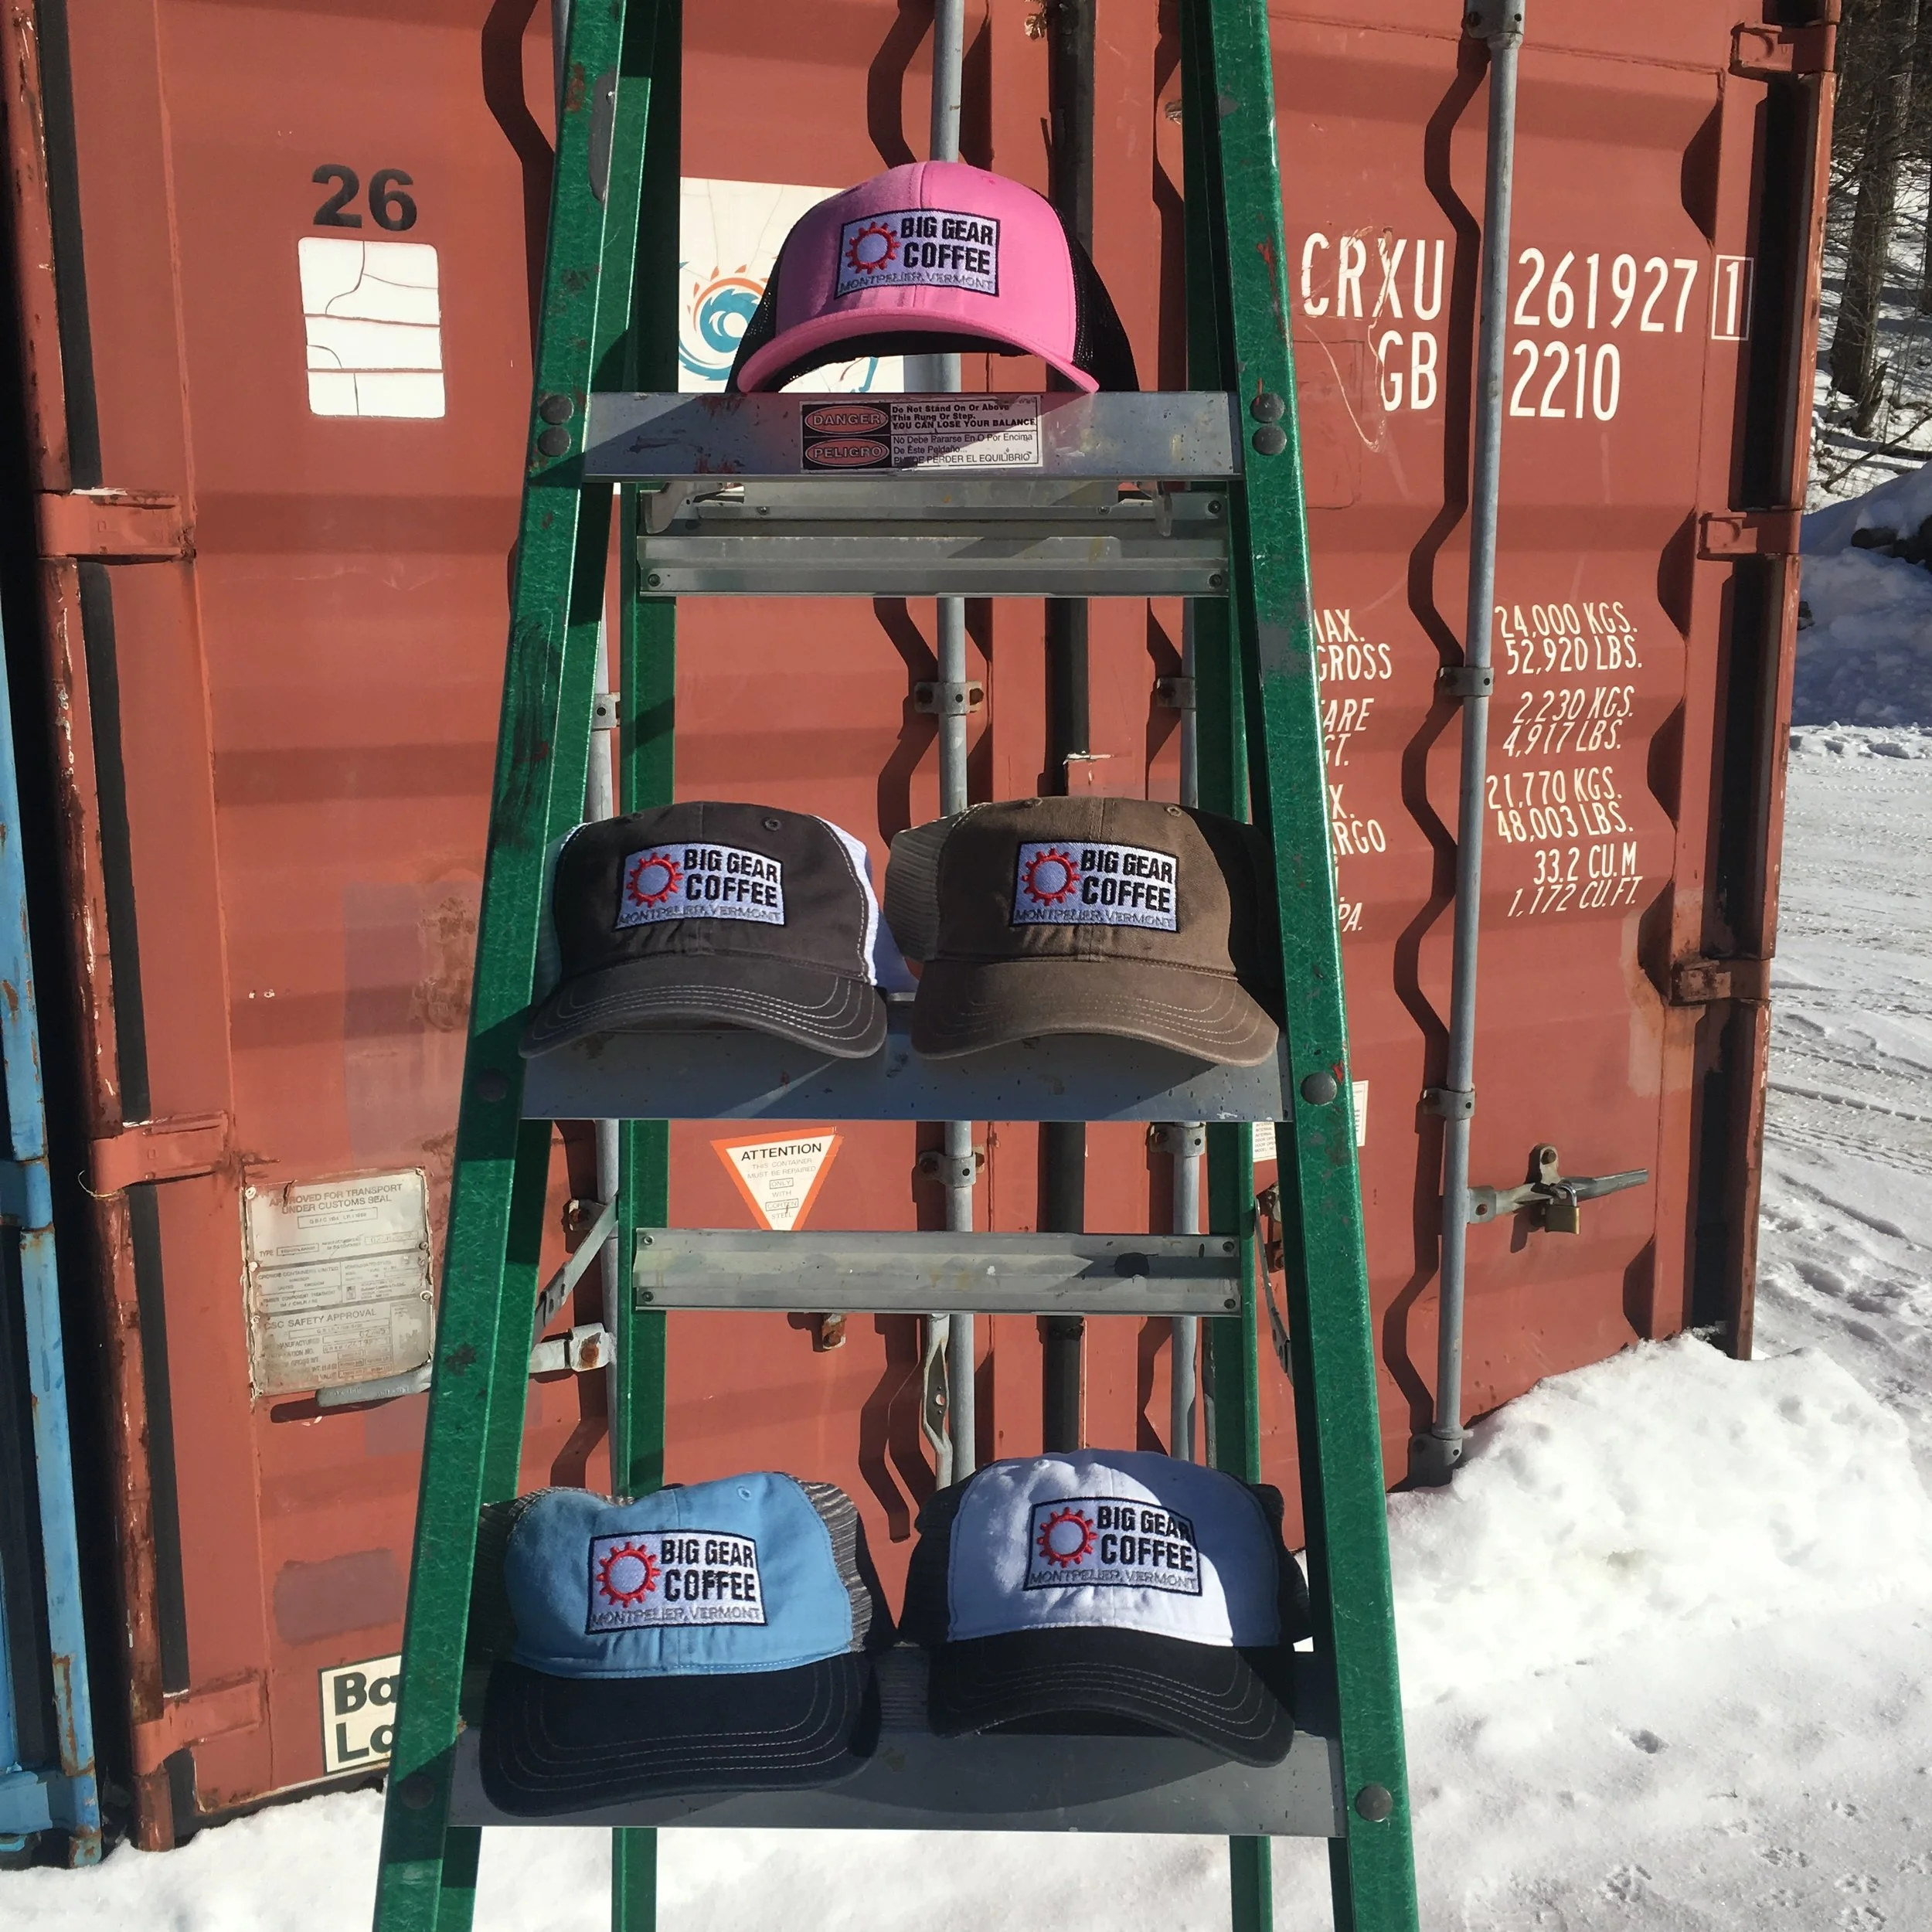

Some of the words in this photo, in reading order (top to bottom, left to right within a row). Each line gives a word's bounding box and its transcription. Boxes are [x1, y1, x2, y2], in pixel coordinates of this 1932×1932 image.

[312, 164, 417, 231] 26
[901, 216, 937, 239] BIG
[942, 218, 994, 246] GEAR
[903, 242, 990, 275] COFFEE
[927, 272, 993, 291] VERMONT
[1301, 232, 1444, 321] CRXU
[1514, 247, 1699, 332] 261927
[1378, 331, 1437, 411] GB
[1509, 339, 1621, 421] 2210
[813, 413, 882, 425] DANGER
[906, 405, 922, 413] Not
[925, 404, 951, 413] Stand
[914, 413, 937, 422] Rung
[953, 412, 975, 421] Step.
[814, 446, 883, 458] PELIGRO
[907, 436, 928, 444] Debe
[964, 434, 975, 442] En
[1004, 433, 1032, 441] Encima
[907, 445, 925, 454] Este
[927, 455, 964, 464] PERDER
[979, 453, 1030, 462] EQUILIBRIO
[1494, 603, 1580, 638] 24,000
[1583, 601, 1638, 634] KGS.
[1505, 636, 1588, 675] 52,920
[1594, 634, 1642, 671] LBS.
[1321, 698, 1374, 732] ARE
[1512, 688, 1585, 725] 2,230
[1587, 685, 1635, 719] KGS.
[1502, 722, 1576, 758] 4,917
[1576, 719, 1623, 751] LBS.
[1486, 770, 1566, 809] 21,770
[1574, 766, 1622, 802] KGS.
[1332, 819, 1386, 855] RGO
[1498, 805, 1579, 842] 48,003
[1579, 801, 1634, 835] LBS.
[684, 849, 723, 871] BIG
[726, 852, 778, 884] GEAR
[1081, 849, 1119, 874] BIG
[1122, 853, 1173, 884] GEAR
[1533, 847, 1580, 885] 33.2
[686, 873, 778, 907] COFFEE
[1082, 876, 1170, 913] COFFEE
[1508, 883, 1577, 917] 1,172
[710, 905, 780, 920] VERMONT
[1106, 911, 1173, 927] VERMONT
[741, 1142, 821, 1161] ATTENTION
[771, 1158, 812, 1168] CONTAINER
[782, 1165, 816, 1175] REPAIRED
[269, 1193, 322, 1207] APROVED
[324, 1190, 344, 1199] FOR
[345, 1183, 403, 1197] TRANSPORT
[281, 1202, 315, 1214] UNDER
[318, 1198, 366, 1210] CUSTOMS
[368, 1194, 392, 1204] SEAL
[264, 1321, 284, 1330] CSC
[287, 1315, 325, 1328] SAFETY
[326, 1308, 376, 1321] APPROVAL
[1097, 1506, 1135, 1531] BIG
[1141, 1510, 1192, 1543] GEAR
[661, 1539, 700, 1565] BIG
[705, 1539, 753, 1568] GEAR
[1100, 1534, 1194, 1572] COFFEE
[665, 1569, 756, 1602] COFFEE
[1124, 1570, 1196, 1590] VERMONT
[689, 1606, 760, 1621] VERMONT
